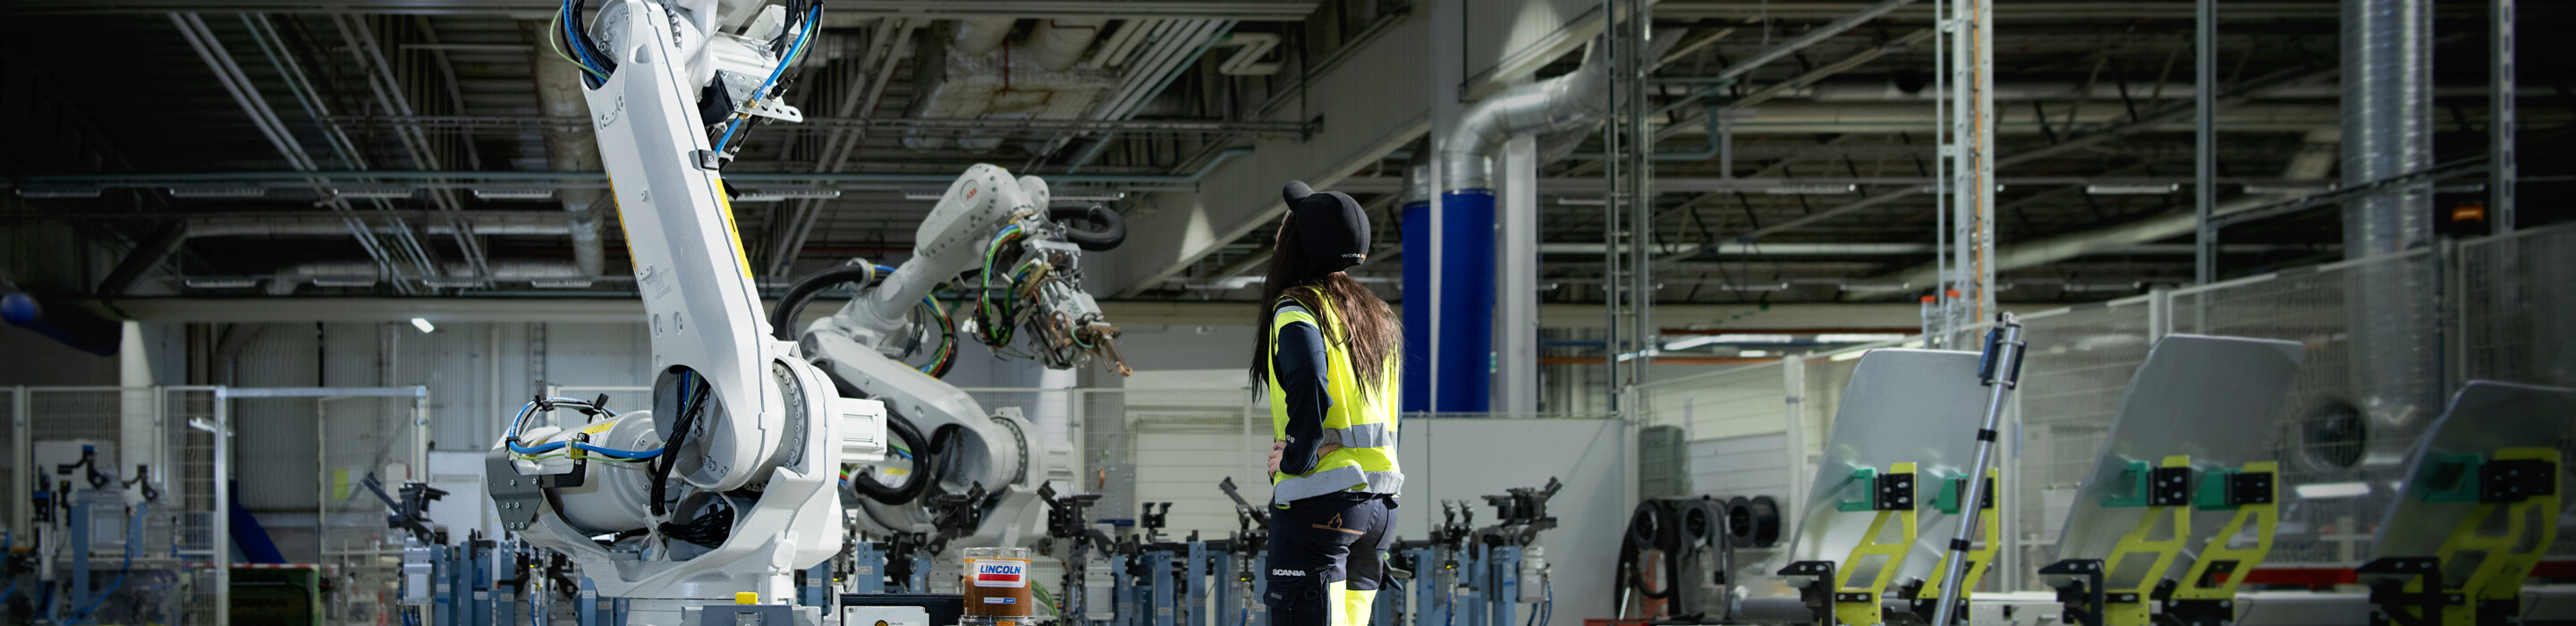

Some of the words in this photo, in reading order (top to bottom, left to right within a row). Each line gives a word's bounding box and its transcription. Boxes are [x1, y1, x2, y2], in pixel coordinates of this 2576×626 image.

[966, 188, 978, 200] ABB
[979, 565, 1021, 574] LINCOLN
[1272, 569, 1306, 577] SCANIA
